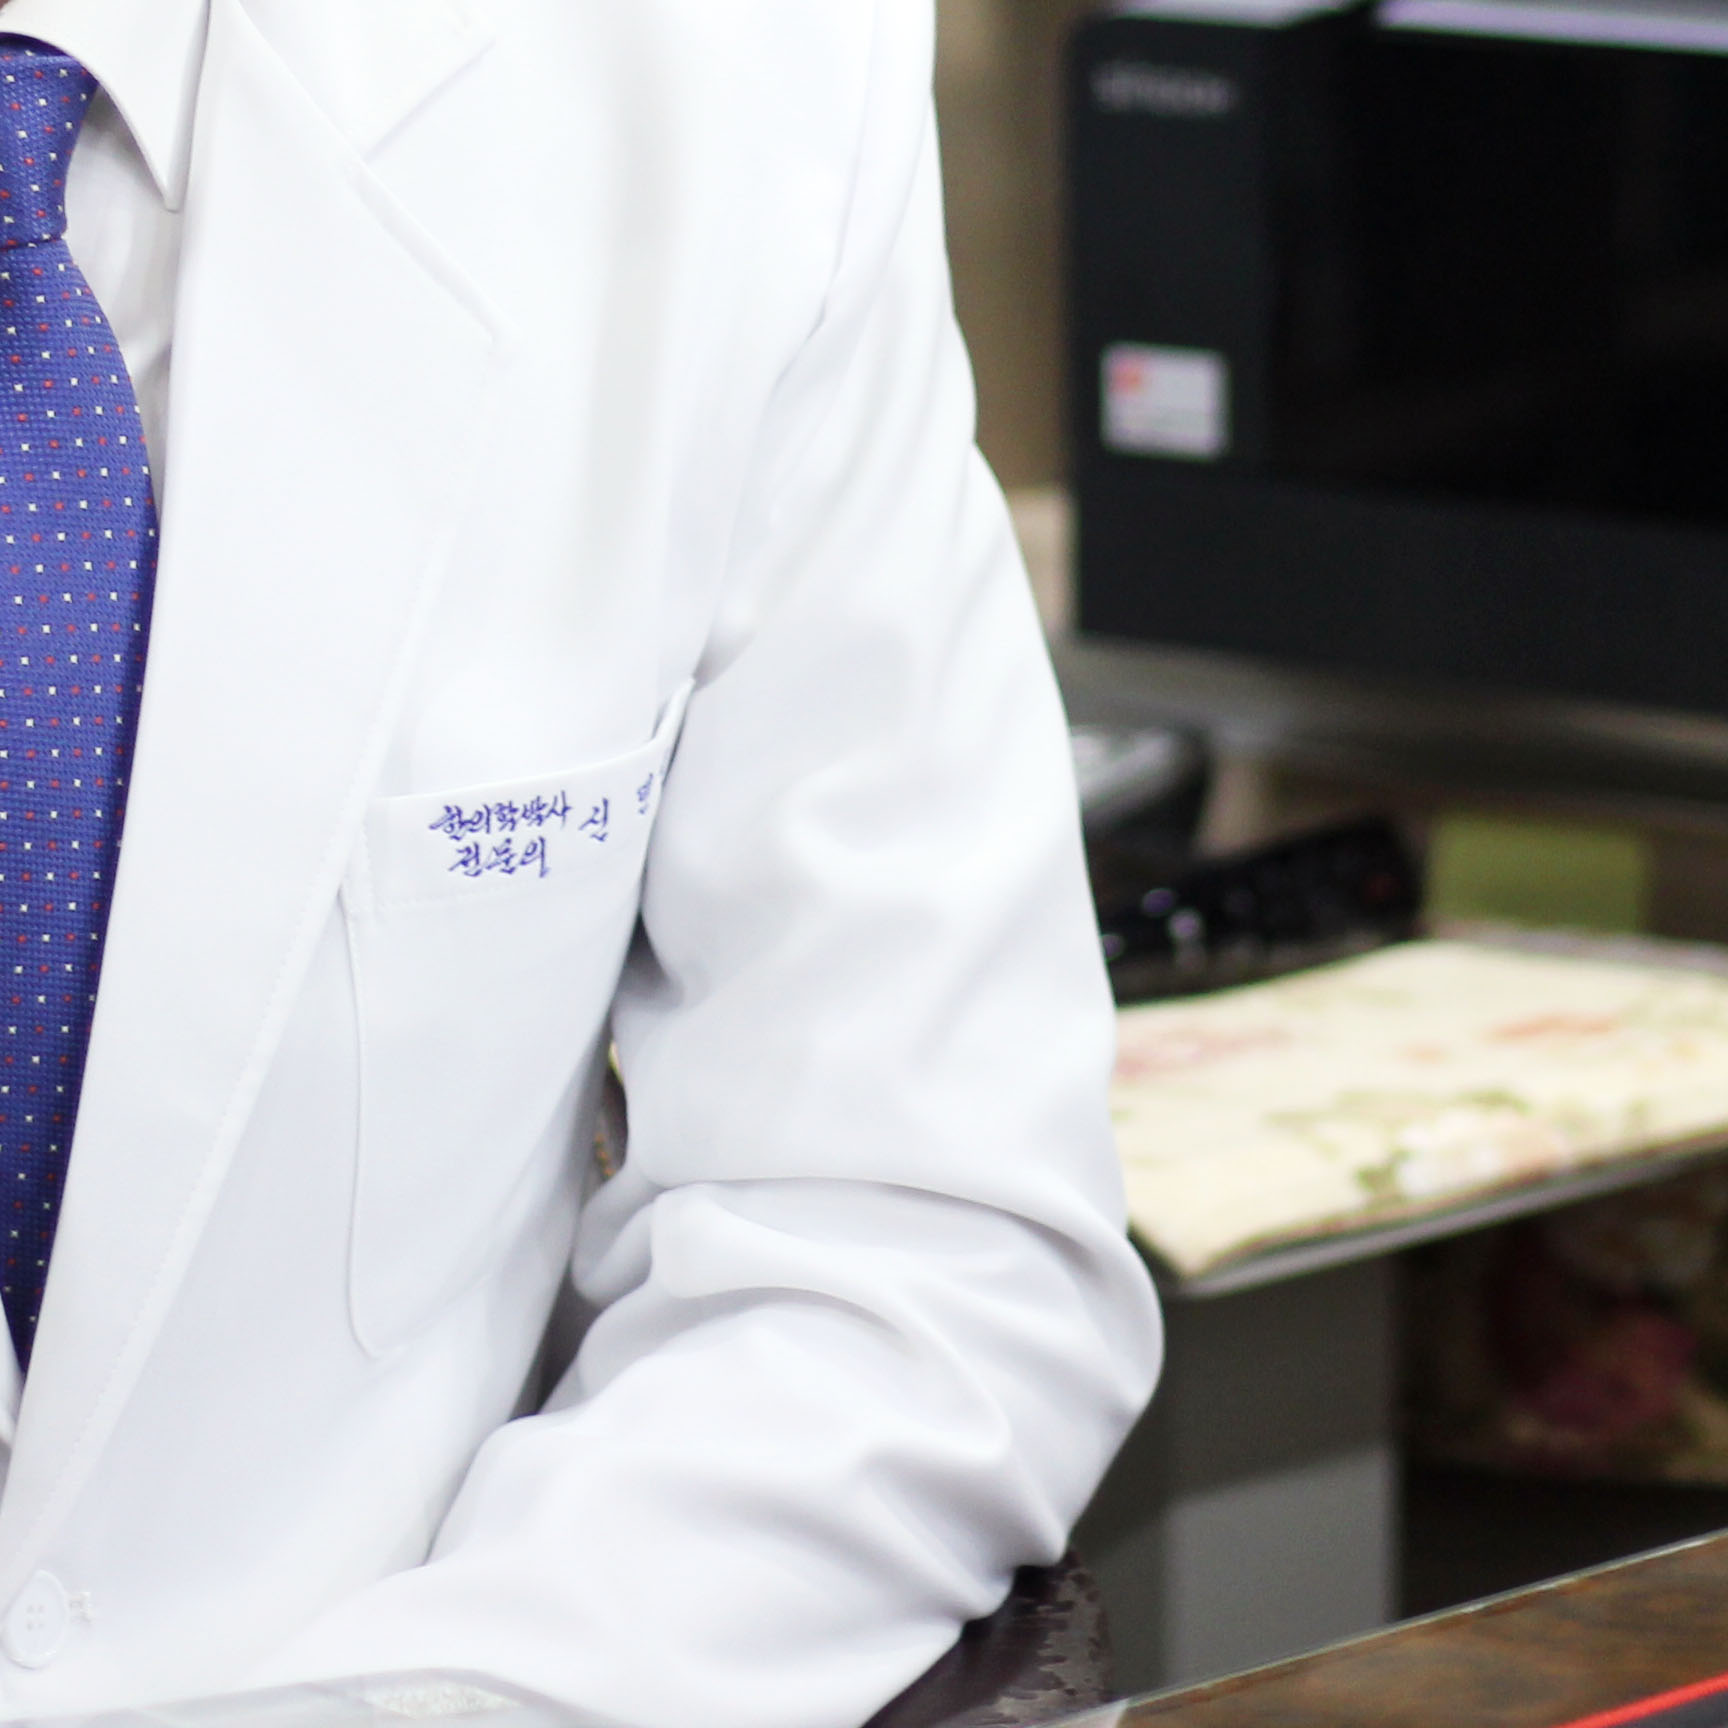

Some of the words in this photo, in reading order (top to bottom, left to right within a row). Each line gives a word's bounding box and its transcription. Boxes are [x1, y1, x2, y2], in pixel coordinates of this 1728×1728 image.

[428, 790, 573, 842] 한의학박사
[578, 797, 610, 843] 신
[447, 834, 551, 878] 전문의
